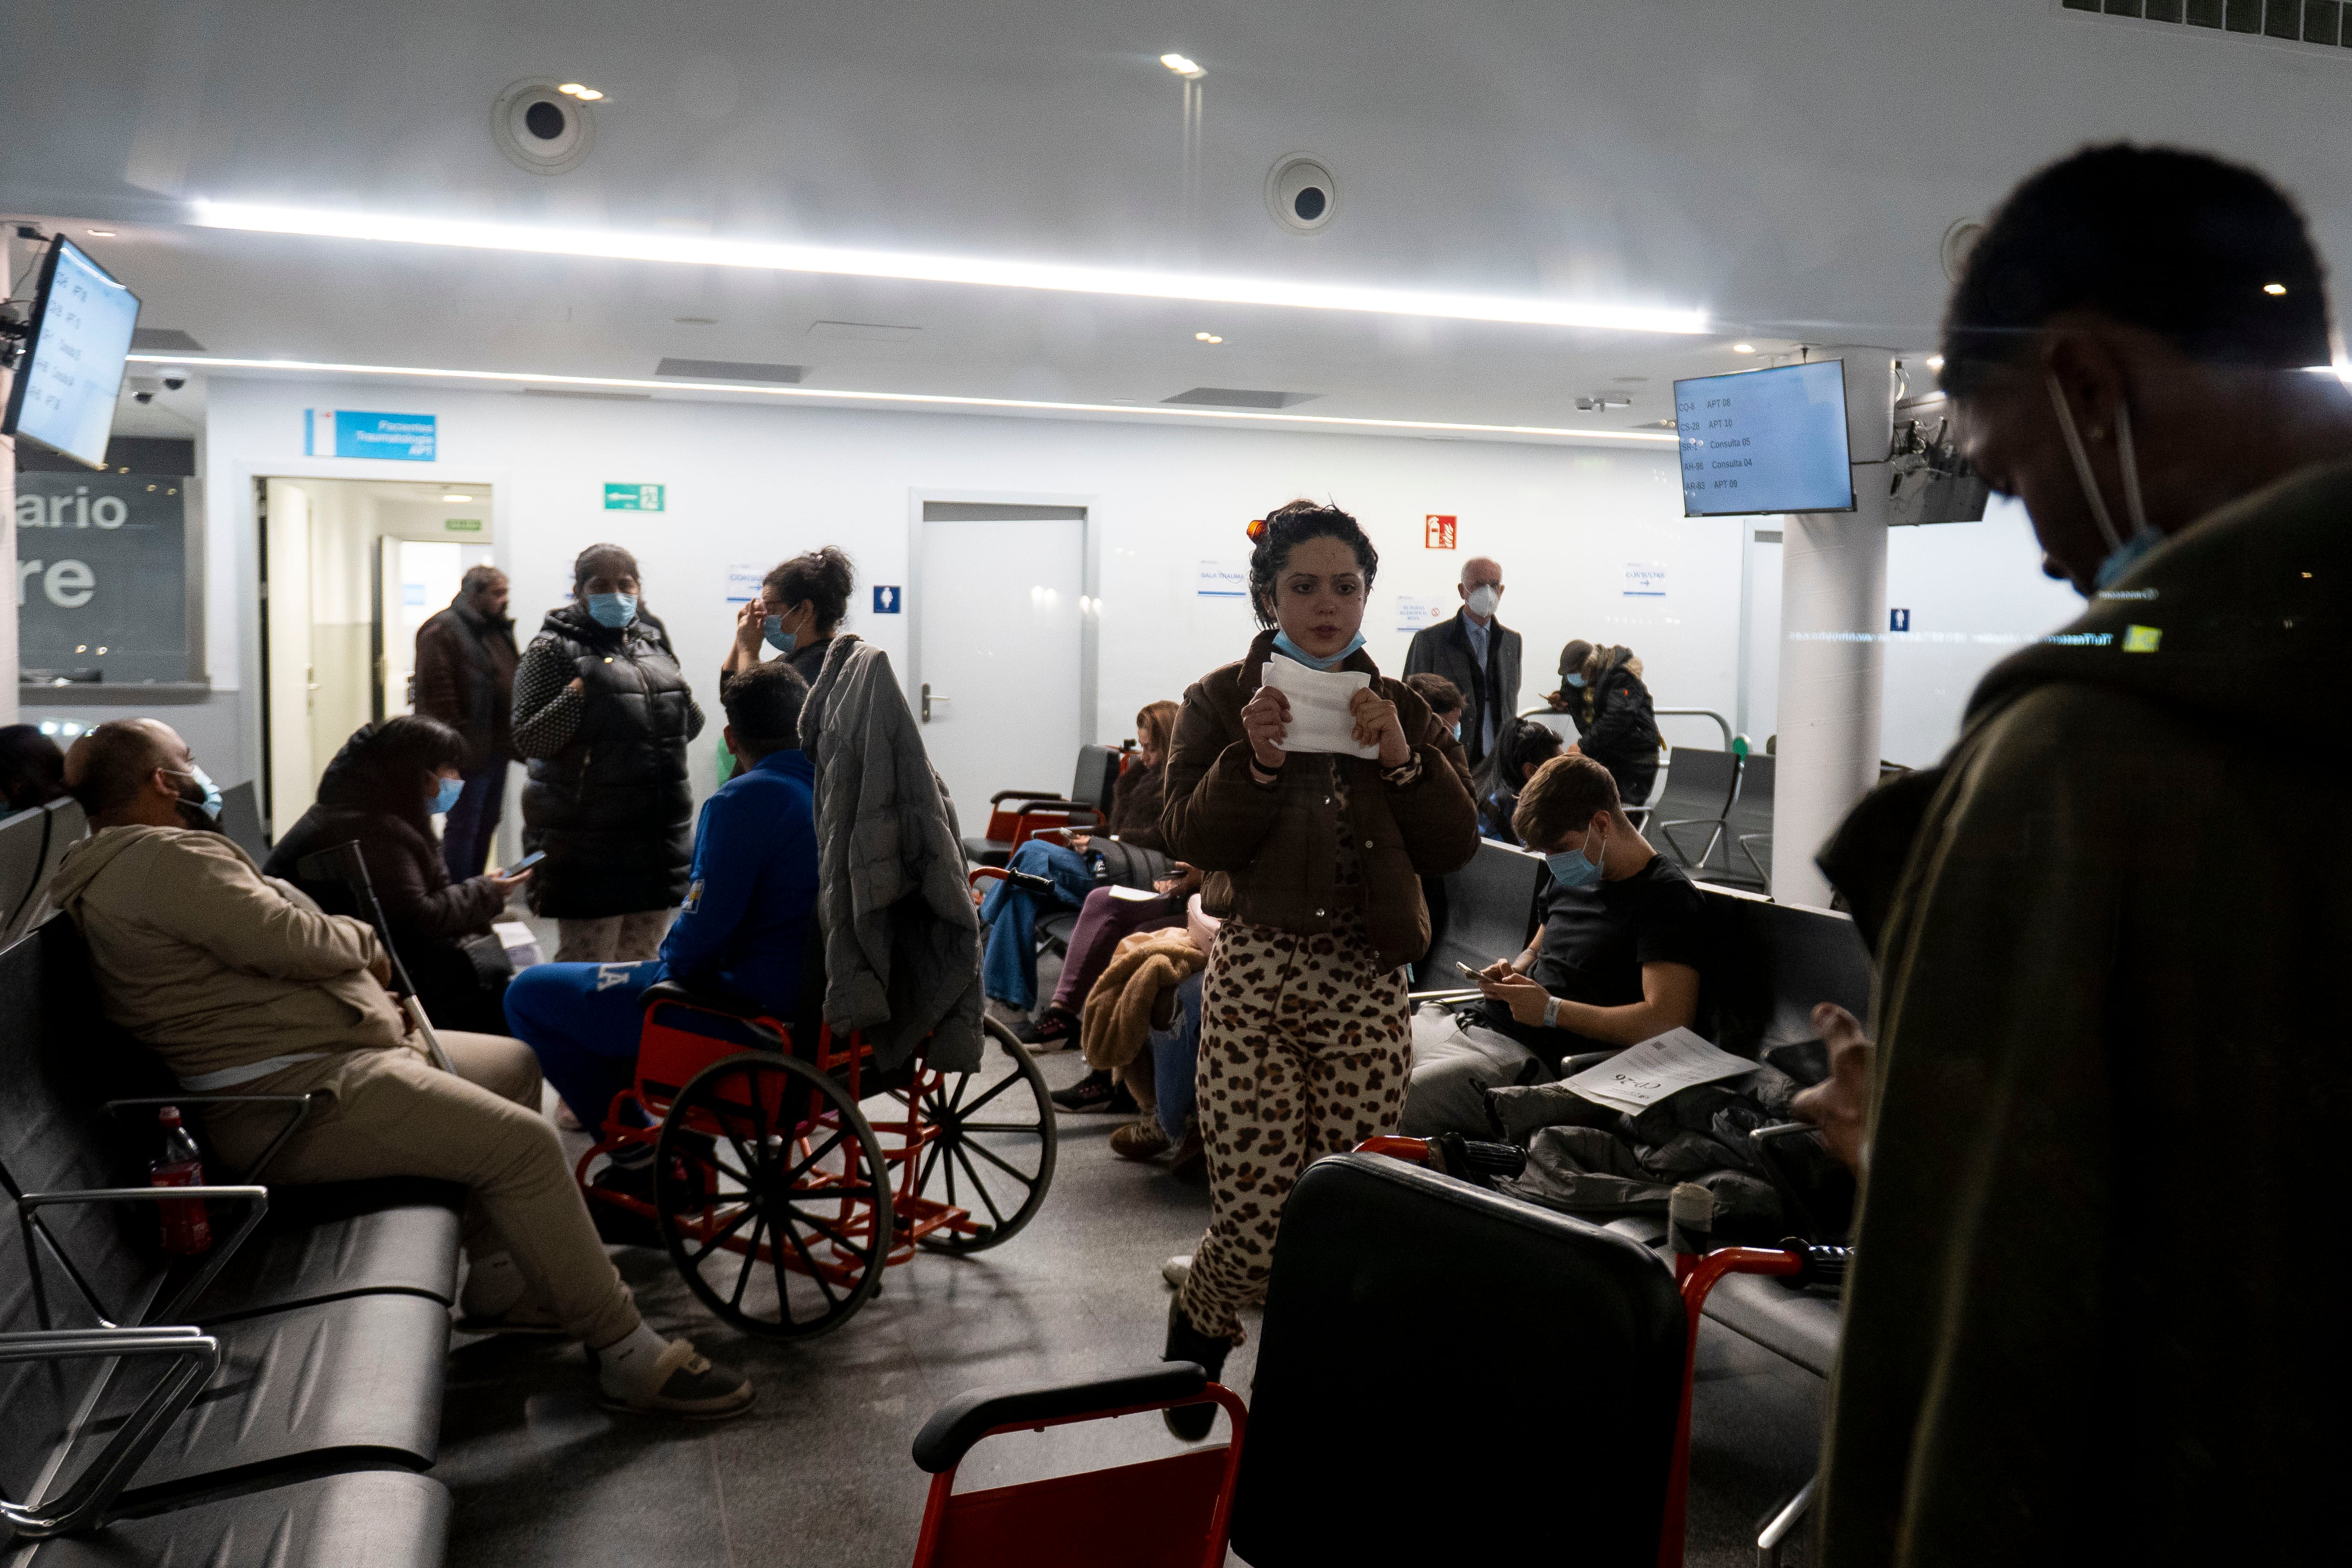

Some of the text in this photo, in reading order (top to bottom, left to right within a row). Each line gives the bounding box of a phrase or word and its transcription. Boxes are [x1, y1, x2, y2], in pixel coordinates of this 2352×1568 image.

[1707, 399, 1721, 408] APT
[1722, 398, 1731, 406] 08
[1709, 420, 1722, 429] APT
[1725, 419, 1733, 428] 10
[1710, 439, 1741, 449] Consulta
[1742, 437, 1751, 446] 05
[1712, 459, 1742, 469] Consulta
[1744, 458, 1752, 467] 04
[1714, 480, 1727, 489] APT
[17, 486, 129, 530] ario
